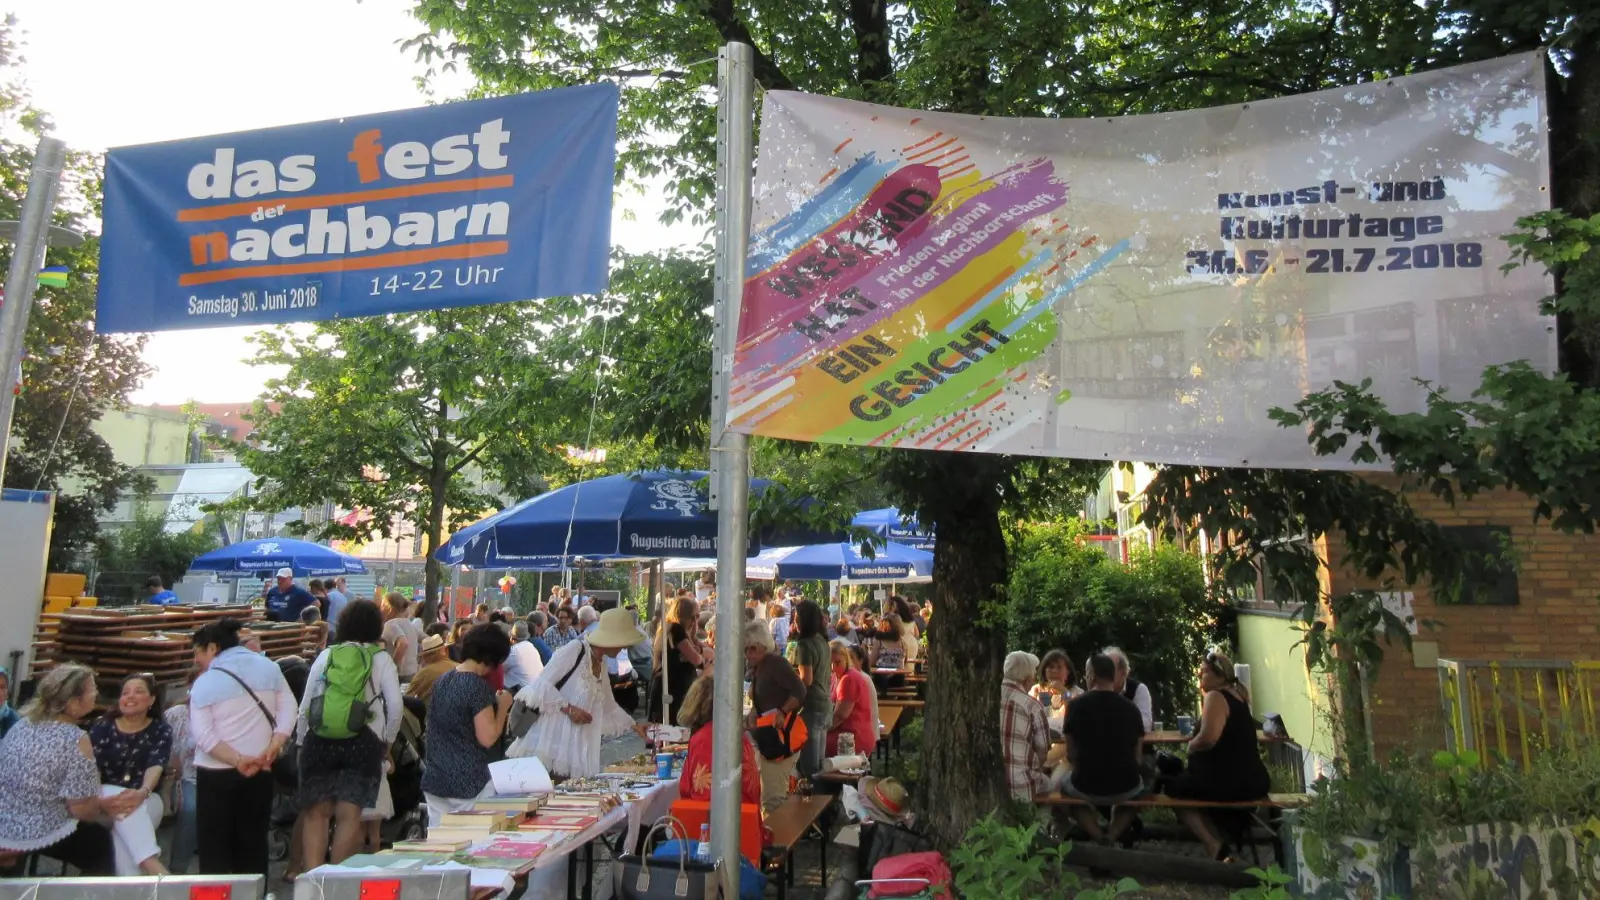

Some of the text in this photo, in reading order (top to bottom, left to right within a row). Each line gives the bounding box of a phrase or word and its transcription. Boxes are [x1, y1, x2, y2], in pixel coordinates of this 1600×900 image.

[187, 118, 511, 200] das fest
[1368, 176, 1447, 202] und
[189, 201, 510, 266] nachbarn
[251, 203, 287, 223] der
[1220, 213, 1443, 242] Kulturtage
[876, 202, 992, 287] Frieden beginnt
[891, 192, 1057, 300] in der Nachbarschaft
[1305, 242, 1483, 274] 21.7.2018
[370, 265, 504, 296] 14-22 Uhr
[188, 286, 317, 318] Samstag 30. Juni 2018
[816, 334, 898, 384] EIN
[849, 318, 1012, 422] GESICHT
